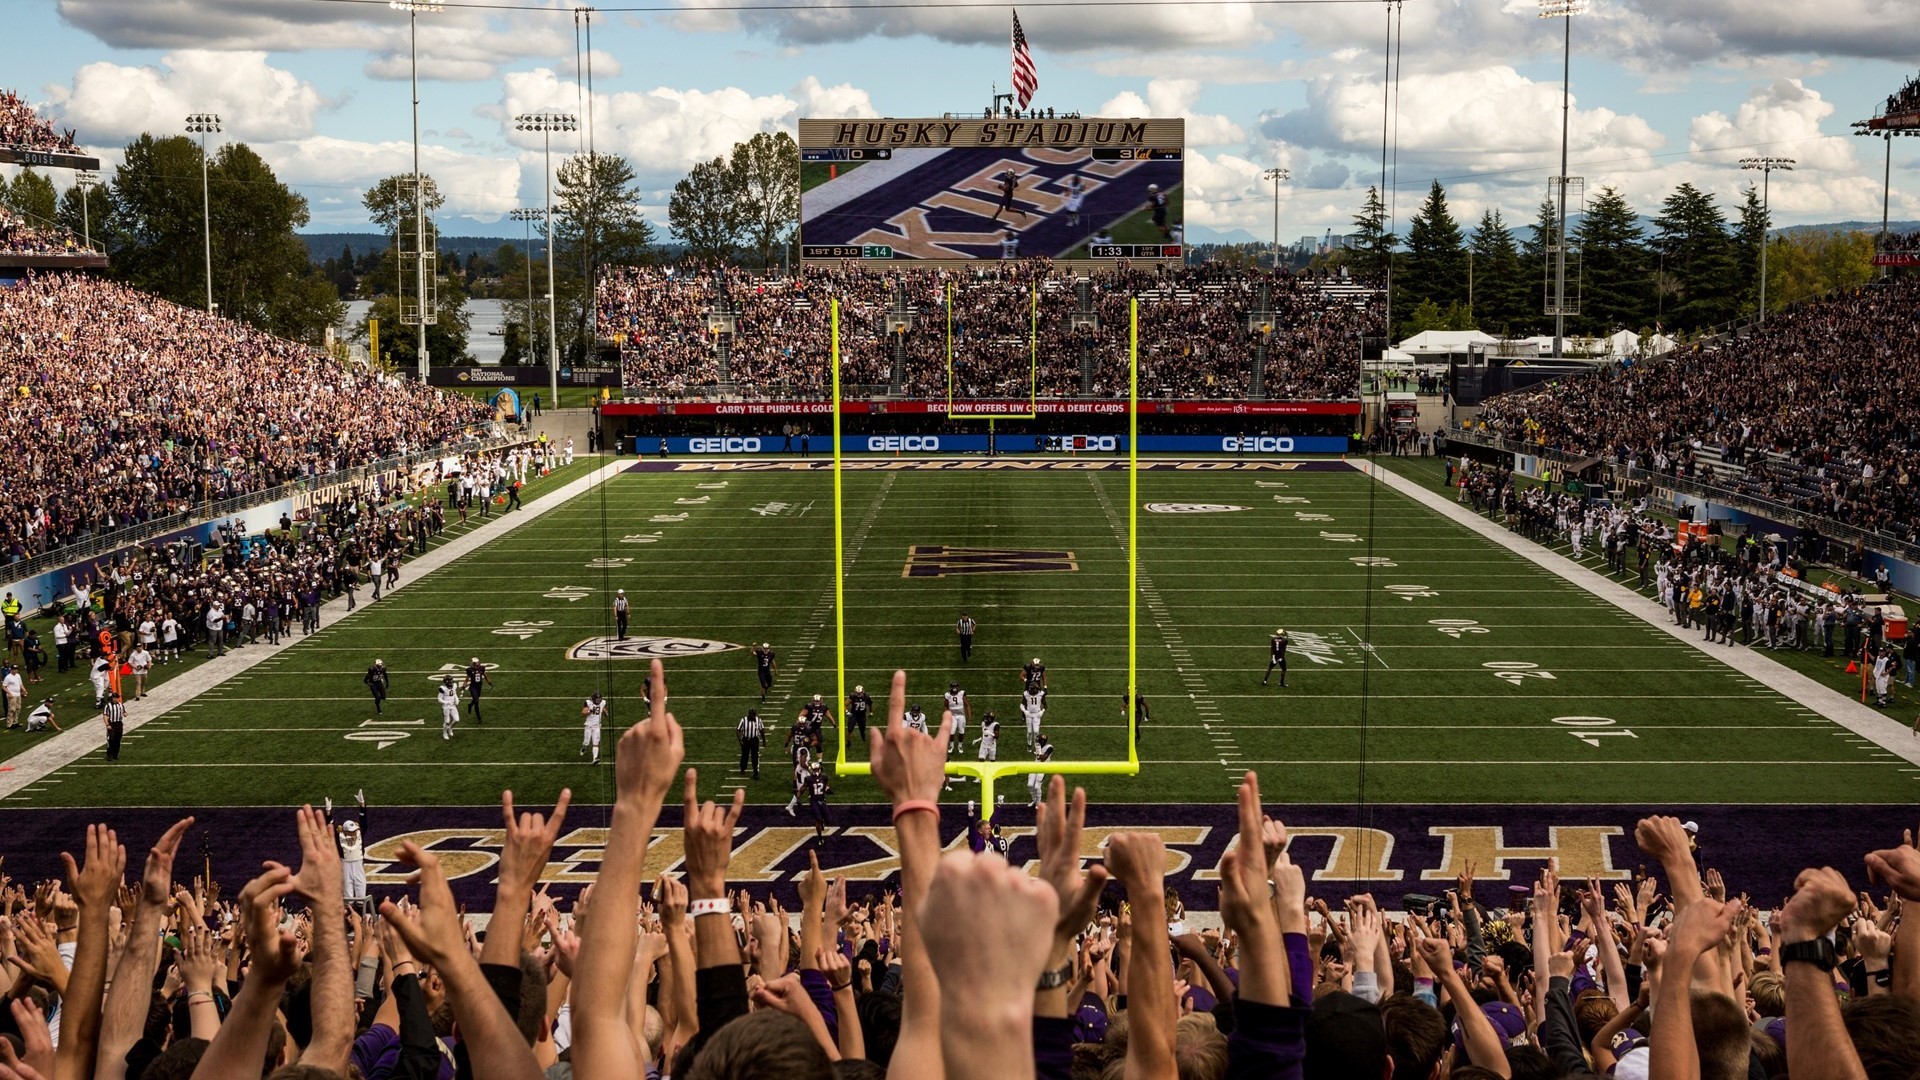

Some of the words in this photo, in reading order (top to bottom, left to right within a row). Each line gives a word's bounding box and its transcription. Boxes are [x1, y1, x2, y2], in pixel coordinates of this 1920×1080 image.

[835, 122, 961, 145] HUSKY
[979, 122, 1149, 145] STADIUM
[25, 153, 54, 165] BOISE
[1120, 150, 1132, 158] 3
[1136, 148, 1152, 160] Cal
[833, 247, 842, 256] &
[874, 247, 887, 256] 14
[1097, 246, 1122, 256] 1:33
[716, 405, 746, 415] CARRY
[748, 405, 765, 413] THE
[767, 405, 801, 413] PURPLE
[803, 404, 810, 413] &
[811, 404, 834, 413] GOLD
[927, 403, 950, 413] BECU
[952, 404, 973, 412] NOW
[975, 404, 1007, 412] OFFERS
[1009, 404, 1024, 412] UW
[1026, 404, 1058, 412] CREDIT
[1058, 404, 1065, 412] &
[1067, 404, 1093, 412] DEBIT
[1094, 404, 1124, 413] CARDS
[689, 437, 761, 453] GEICO
[868, 436, 940, 452] GEICO
[1073, 438, 1087, 449] 40
[1222, 436, 1294, 452] GEICO
[673, 461, 1307, 472] WASHINGTON
[763, 658, 769, 667] 3
[1031, 671, 1042, 681] 72
[1481, 661, 1558, 680] 20
[952, 696, 959, 705] 9
[1030, 697, 1038, 705] 11
[855, 702, 866, 711] 79
[812, 712, 823, 722] 75
[343, 719, 425, 741] 10
[1550, 716, 1639, 739] 10
[812, 782, 824, 795] 12
[999, 839, 1007, 851] 8
